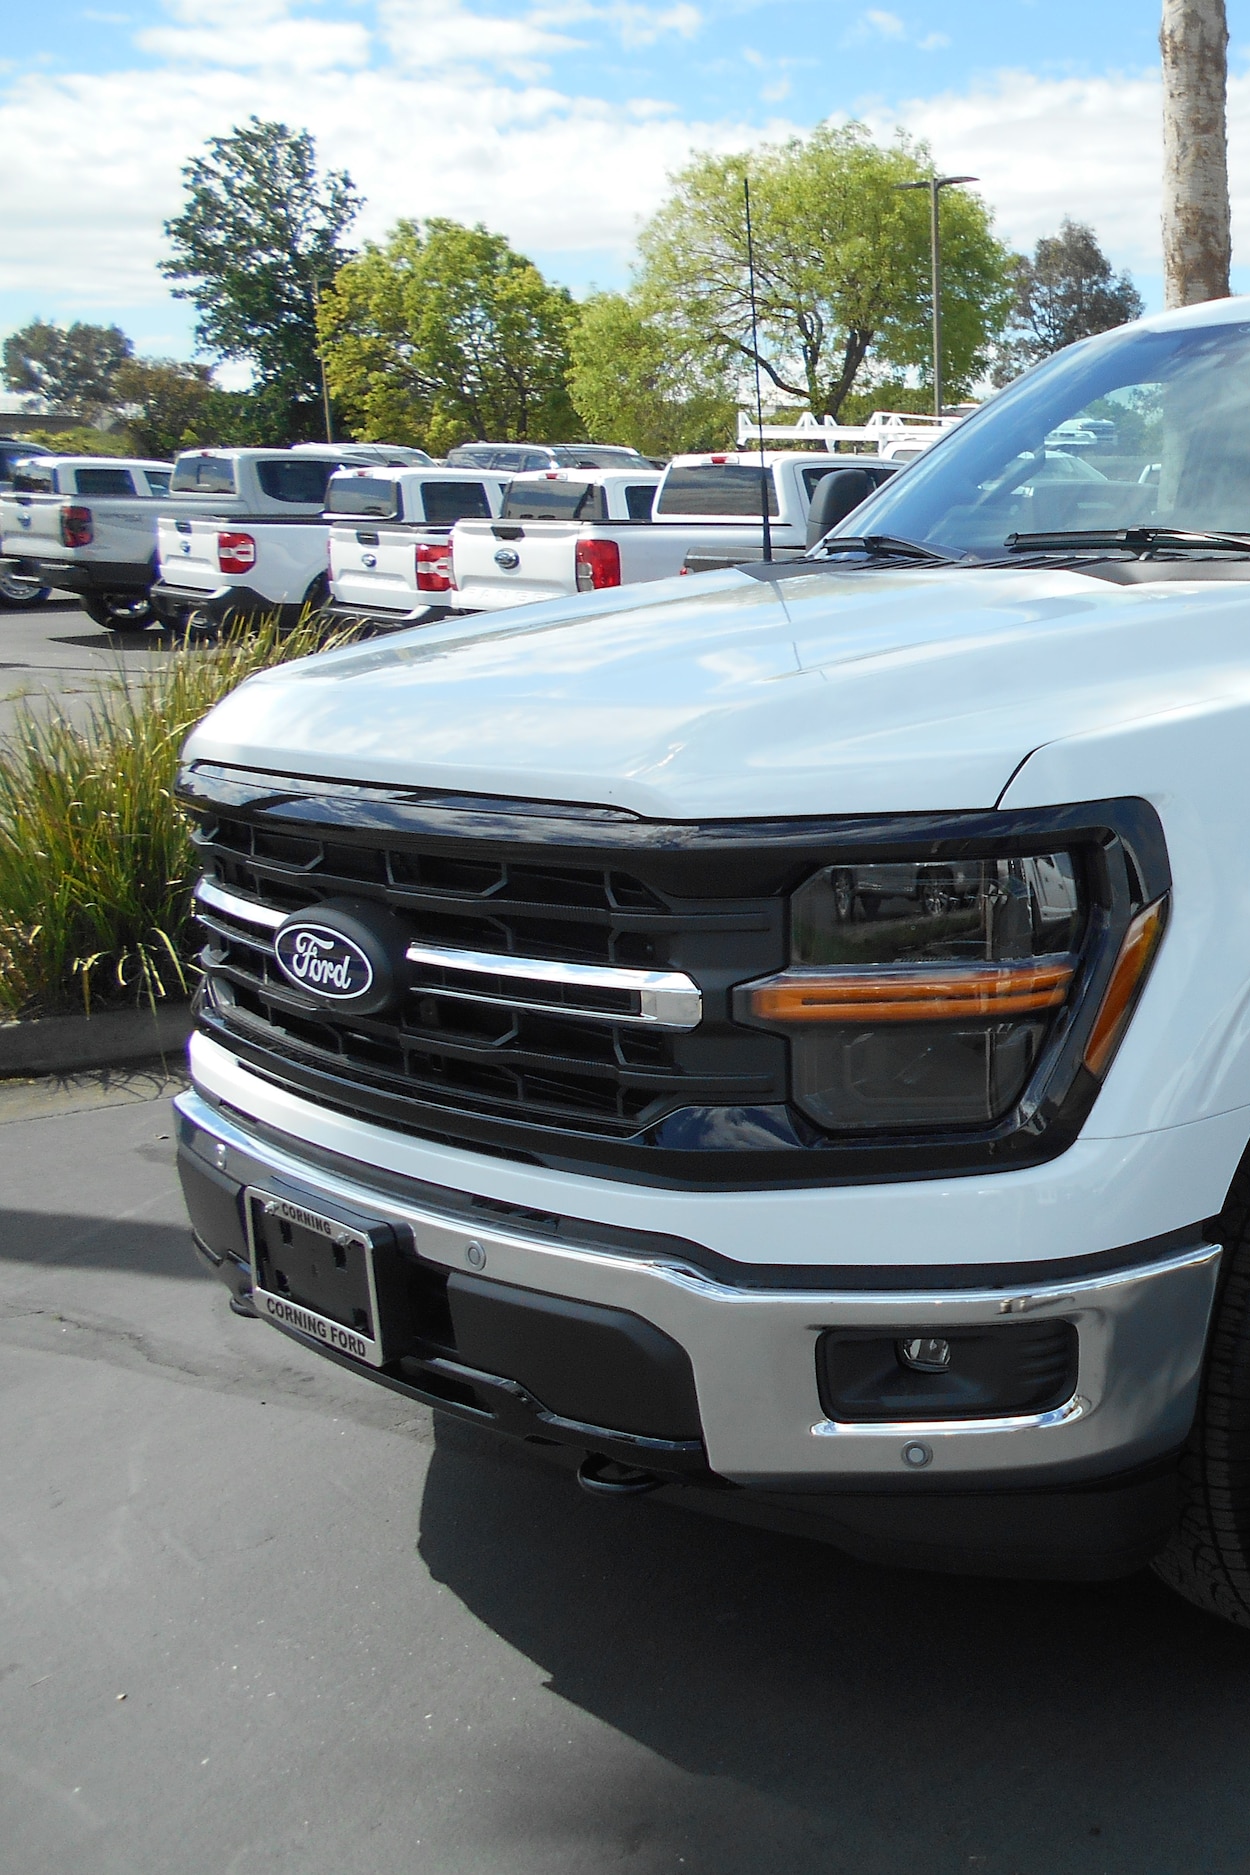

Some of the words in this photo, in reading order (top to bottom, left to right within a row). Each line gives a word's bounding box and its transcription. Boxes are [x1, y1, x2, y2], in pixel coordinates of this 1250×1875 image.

[292, 931, 352, 990] Ford
[282, 1202, 332, 1235] CORNING
[266, 1297, 327, 1338] CORNING
[330, 1325, 366, 1357] FORD
